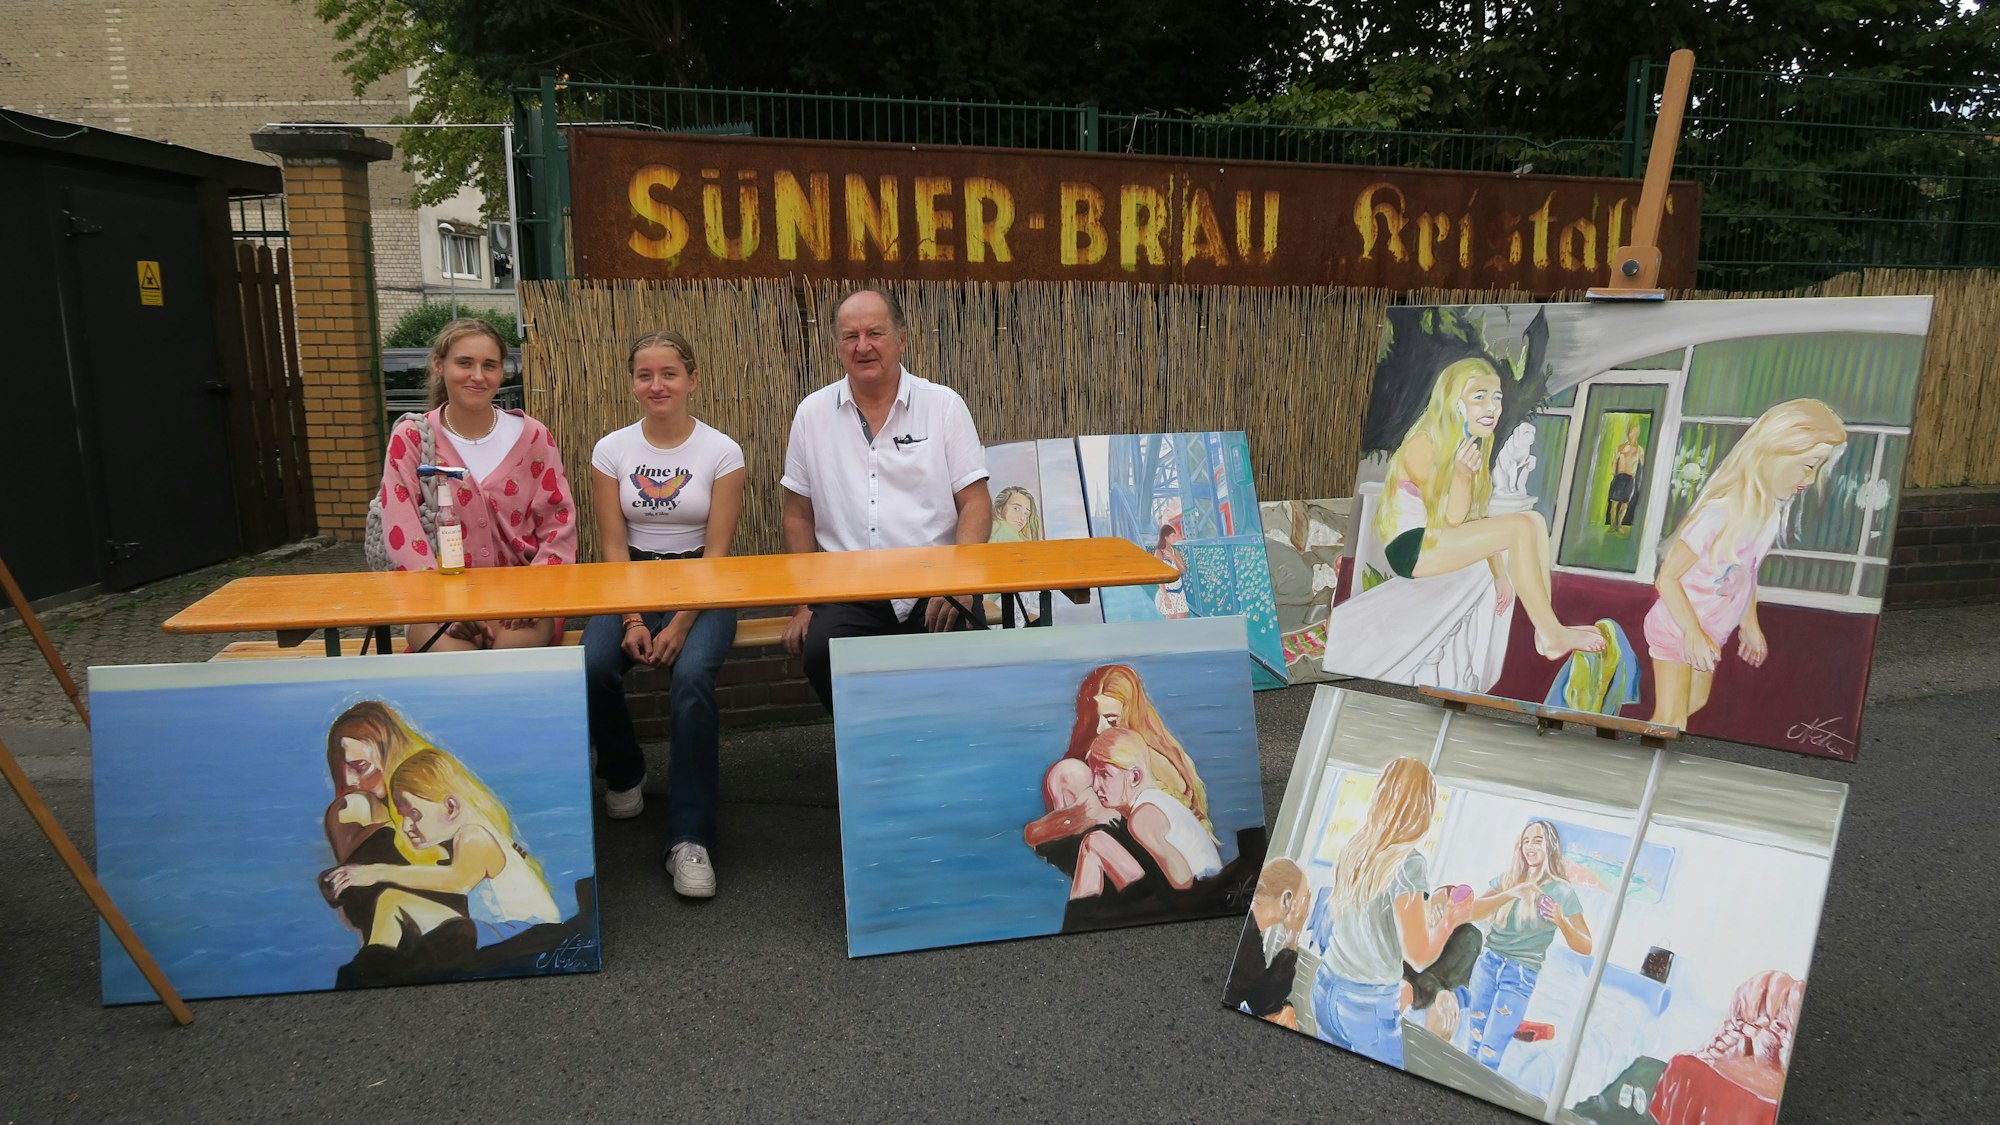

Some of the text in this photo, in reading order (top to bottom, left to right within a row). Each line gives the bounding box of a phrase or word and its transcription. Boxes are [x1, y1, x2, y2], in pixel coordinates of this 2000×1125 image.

[635, 464, 690, 477] time to
[632, 499, 680, 510] enjoy
